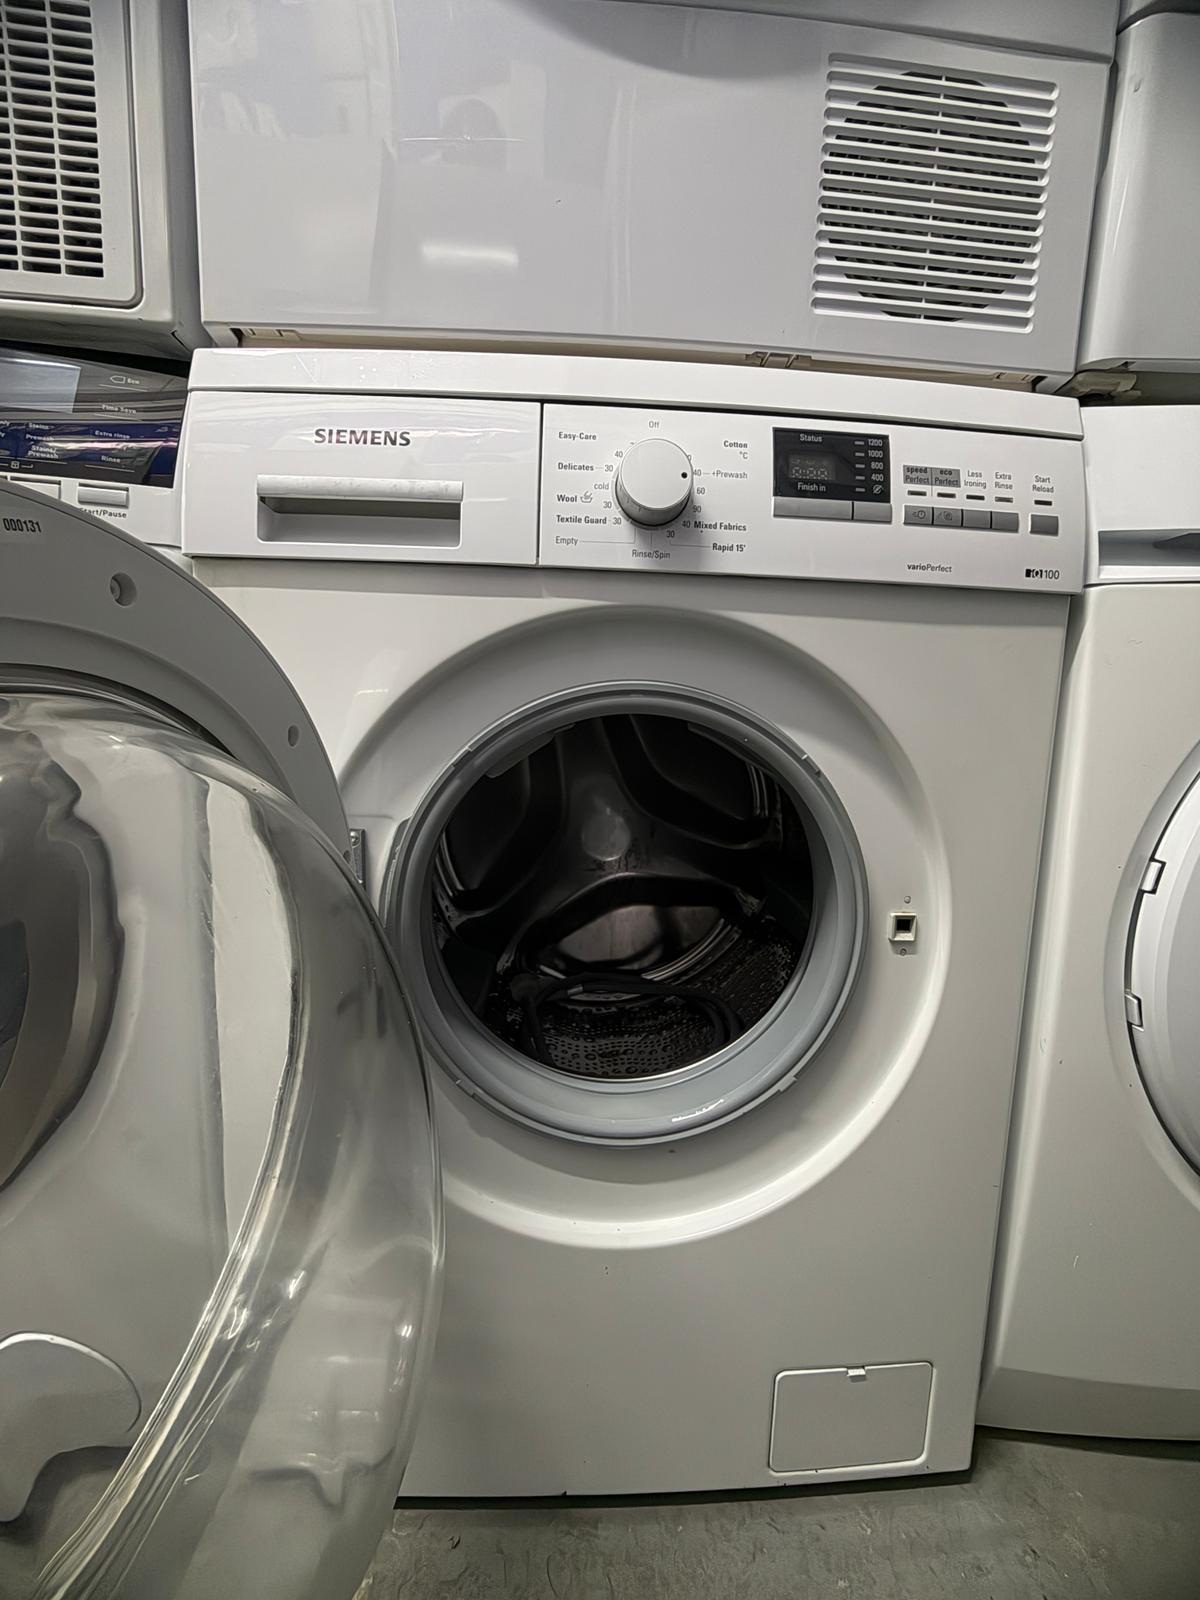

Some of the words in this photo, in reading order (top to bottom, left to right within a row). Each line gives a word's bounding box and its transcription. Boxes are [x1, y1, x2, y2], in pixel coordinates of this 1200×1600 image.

[648, 420, 660, 429] Off
[314, 428, 411, 446] SIEMENS
[558, 431, 597, 441] Easy-Care
[799, 434, 823, 443] Status
[723, 440, 748, 449] Cotton
[867, 438, 883, 447] 1200
[28, 450, 59, 459] Prewash
[614, 450, 623, 458] 40
[867, 450, 884, 458] 1000
[101, 455, 121, 463] Rinse
[557, 463, 594, 471] Delicates
[604, 464, 613, 472] 30
[870, 462, 884, 470] 800
[906, 465, 928, 475] speed
[692, 469, 702, 477] 40
[712, 470, 748, 479] +Prewash
[870, 473, 884, 482] 400
[967, 470, 983, 479] Less
[994, 472, 1012, 481] Extra
[905, 475, 930, 484] Perfect
[934, 476, 959, 486] Perfect
[1034, 475, 1051, 484] Start
[593, 482, 609, 490] cold
[797, 482, 818, 492] Finish
[818, 483, 827, 493] in
[964, 479, 987, 490] Ironing
[994, 481, 1014, 490] Rinse
[1032, 484, 1054, 494] Reload
[696, 487, 706, 495] 60
[557, 494, 578, 503] Wool
[603, 501, 612, 509] 30
[693, 505, 702, 513] 90
[556, 515, 583, 524] Textile
[584, 516, 607, 525] Guard
[612, 517, 622, 525] 30
[3, 518, 42, 533] 000131
[693, 521, 718, 530] Mixed
[719, 523, 747, 532] Fabrics
[555, 536, 579, 546] Empty
[712, 543, 734, 553] Rapid
[631, 549, 671, 560] Rinse/Spin
[907, 563, 952, 573] varioPerfect
